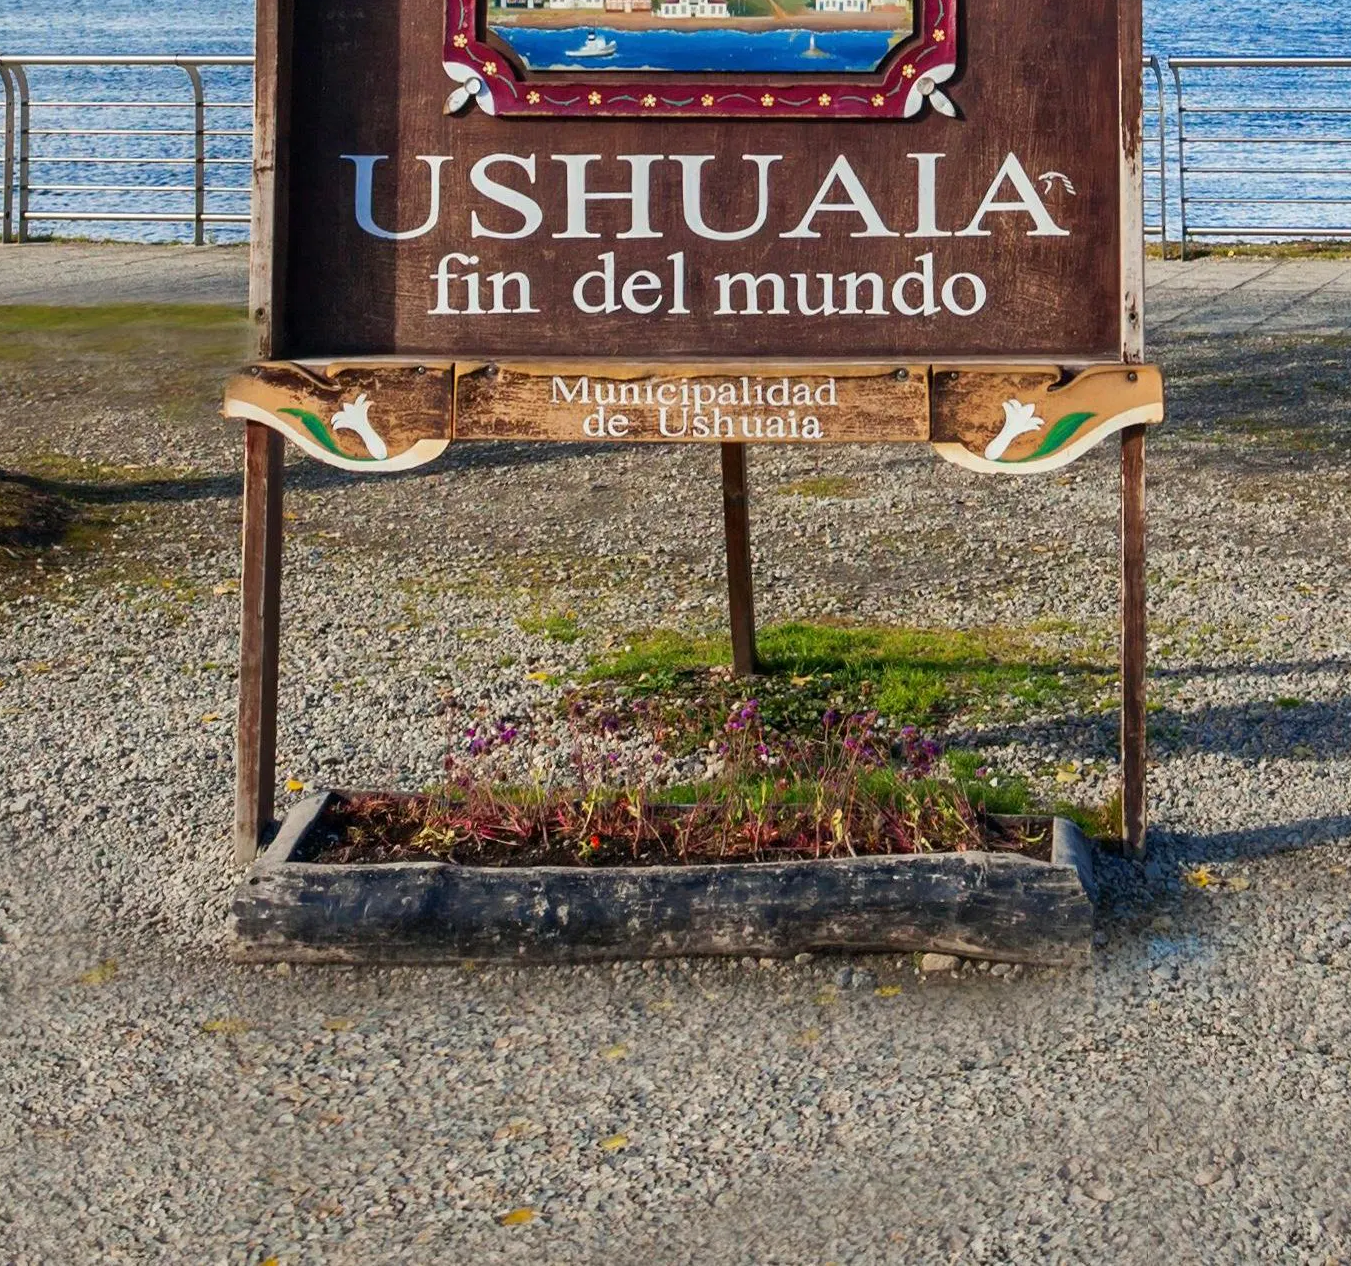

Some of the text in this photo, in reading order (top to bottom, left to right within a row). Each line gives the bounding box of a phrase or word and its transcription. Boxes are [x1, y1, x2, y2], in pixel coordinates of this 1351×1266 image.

[340, 151, 1071, 241] USHUAIA
[427, 251, 988, 317] fin del mundo
[550, 376, 839, 414] Municipalidad
[582, 405, 824, 439] de Ushuaia
